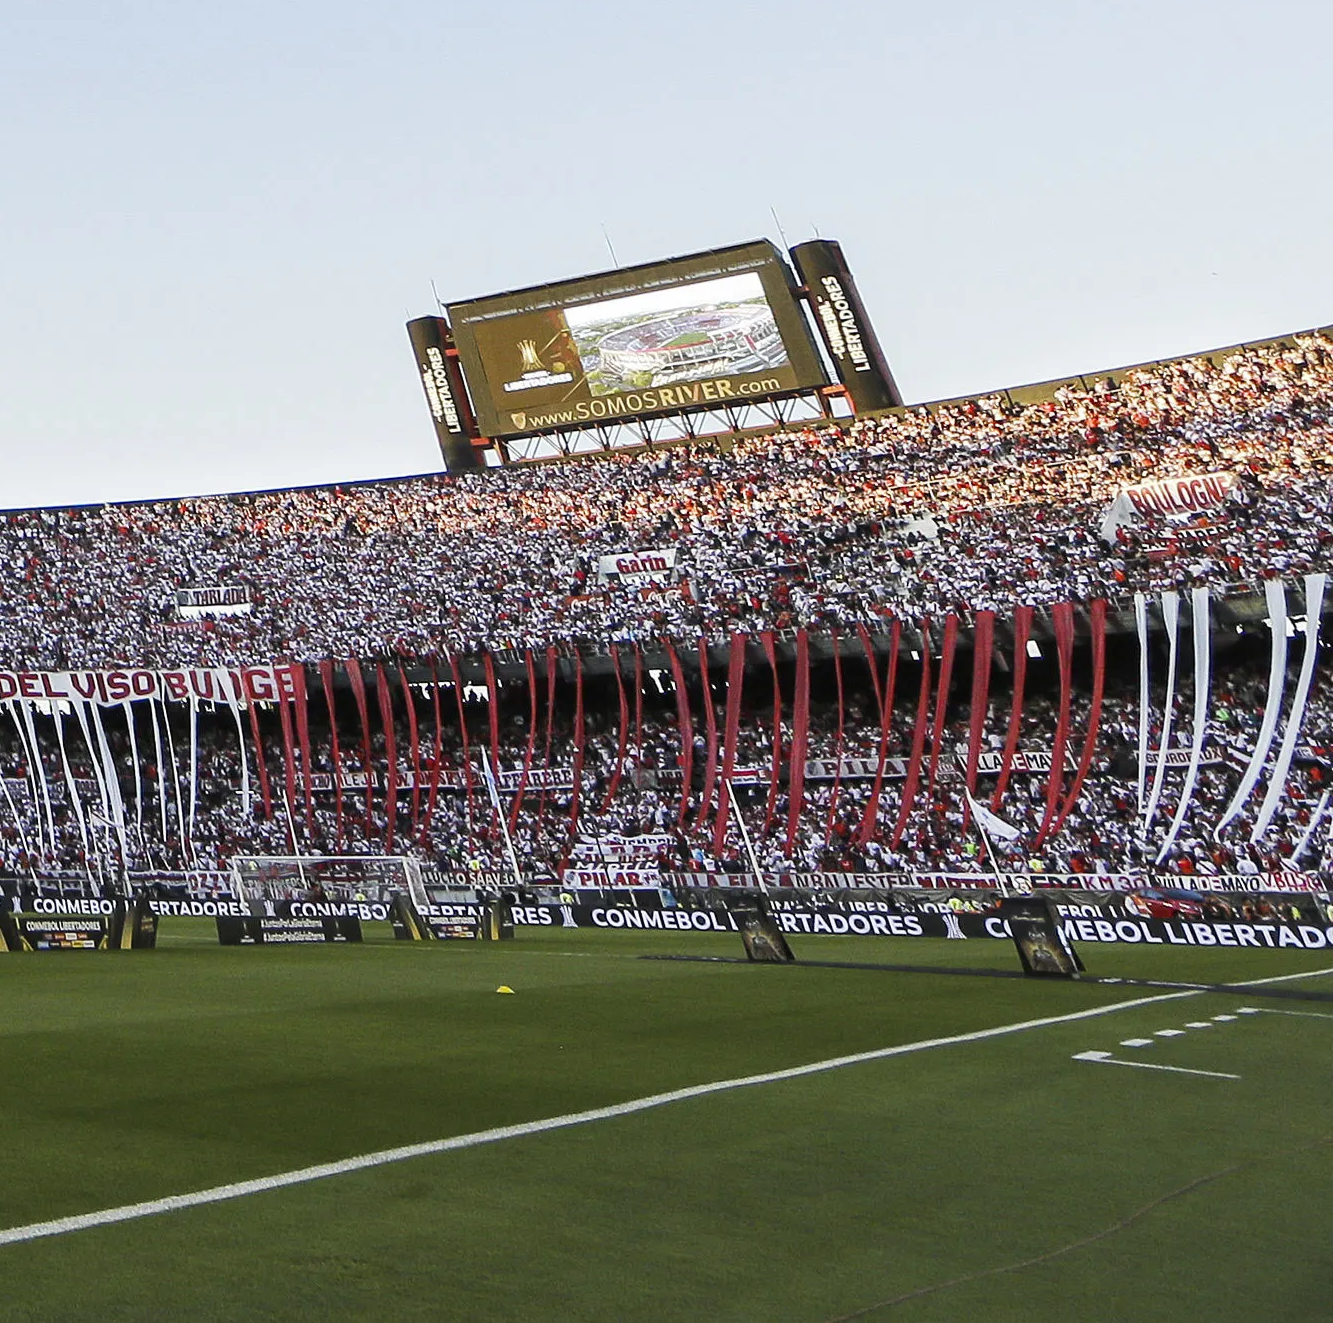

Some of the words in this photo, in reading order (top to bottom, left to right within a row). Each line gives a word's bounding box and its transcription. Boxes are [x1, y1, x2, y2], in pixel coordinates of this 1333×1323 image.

[822, 276, 871, 372] LIBERTADORES
[426, 347, 462, 434] LIBERTADORES
[530, 377, 781, 427] www.SOMOSRIVER.com
[1127, 477, 1230, 522] BOULOGNE
[616, 555, 667, 574] Garin
[69, 670, 155, 702] VISO
[187, 872, 232, 892] OZZY
[578, 871, 641, 886] PILAR
[591, 907, 727, 931] CONMEBOL
